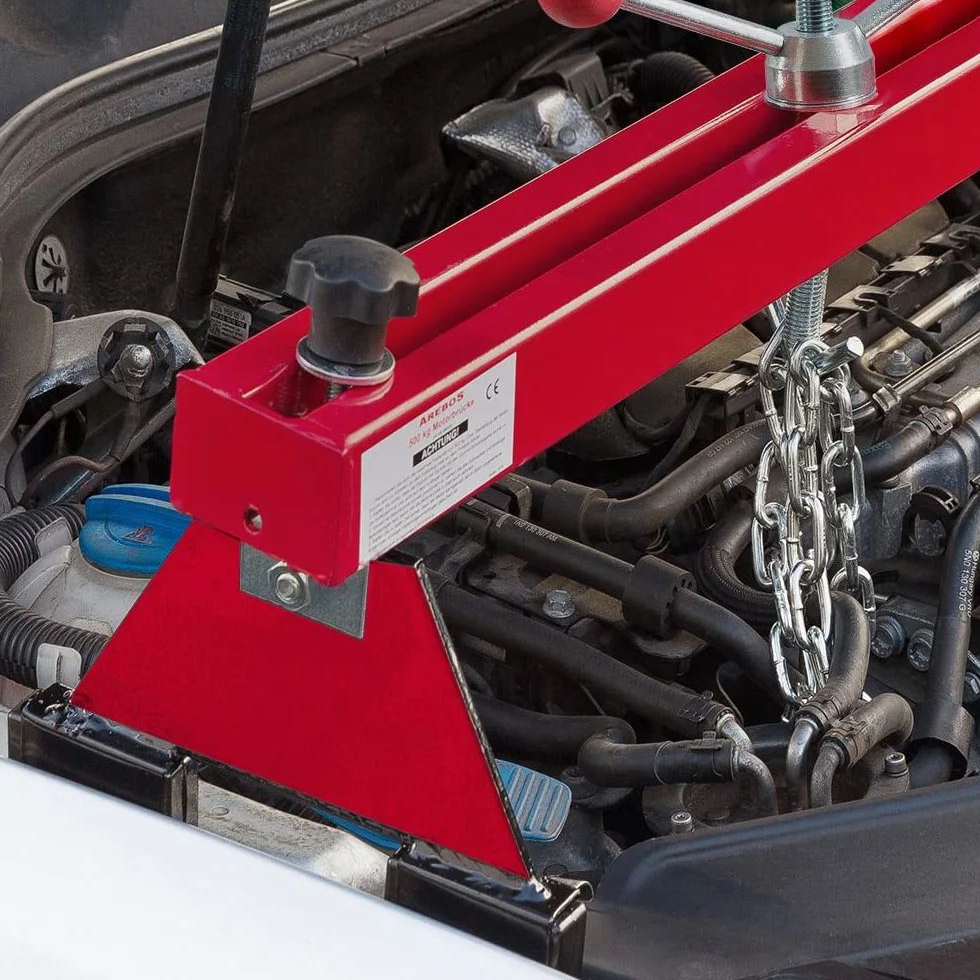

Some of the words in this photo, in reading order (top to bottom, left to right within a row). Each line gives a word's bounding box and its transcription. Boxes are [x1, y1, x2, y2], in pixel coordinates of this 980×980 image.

[419, 391, 465, 427] AREBOS
[421, 426, 460, 460] ACHTUNG!
[964, 548, 973, 567] 5N0
[960, 569, 969, 584] 130
[959, 585, 968, 601] 307
[958, 603, 966, 611] G
